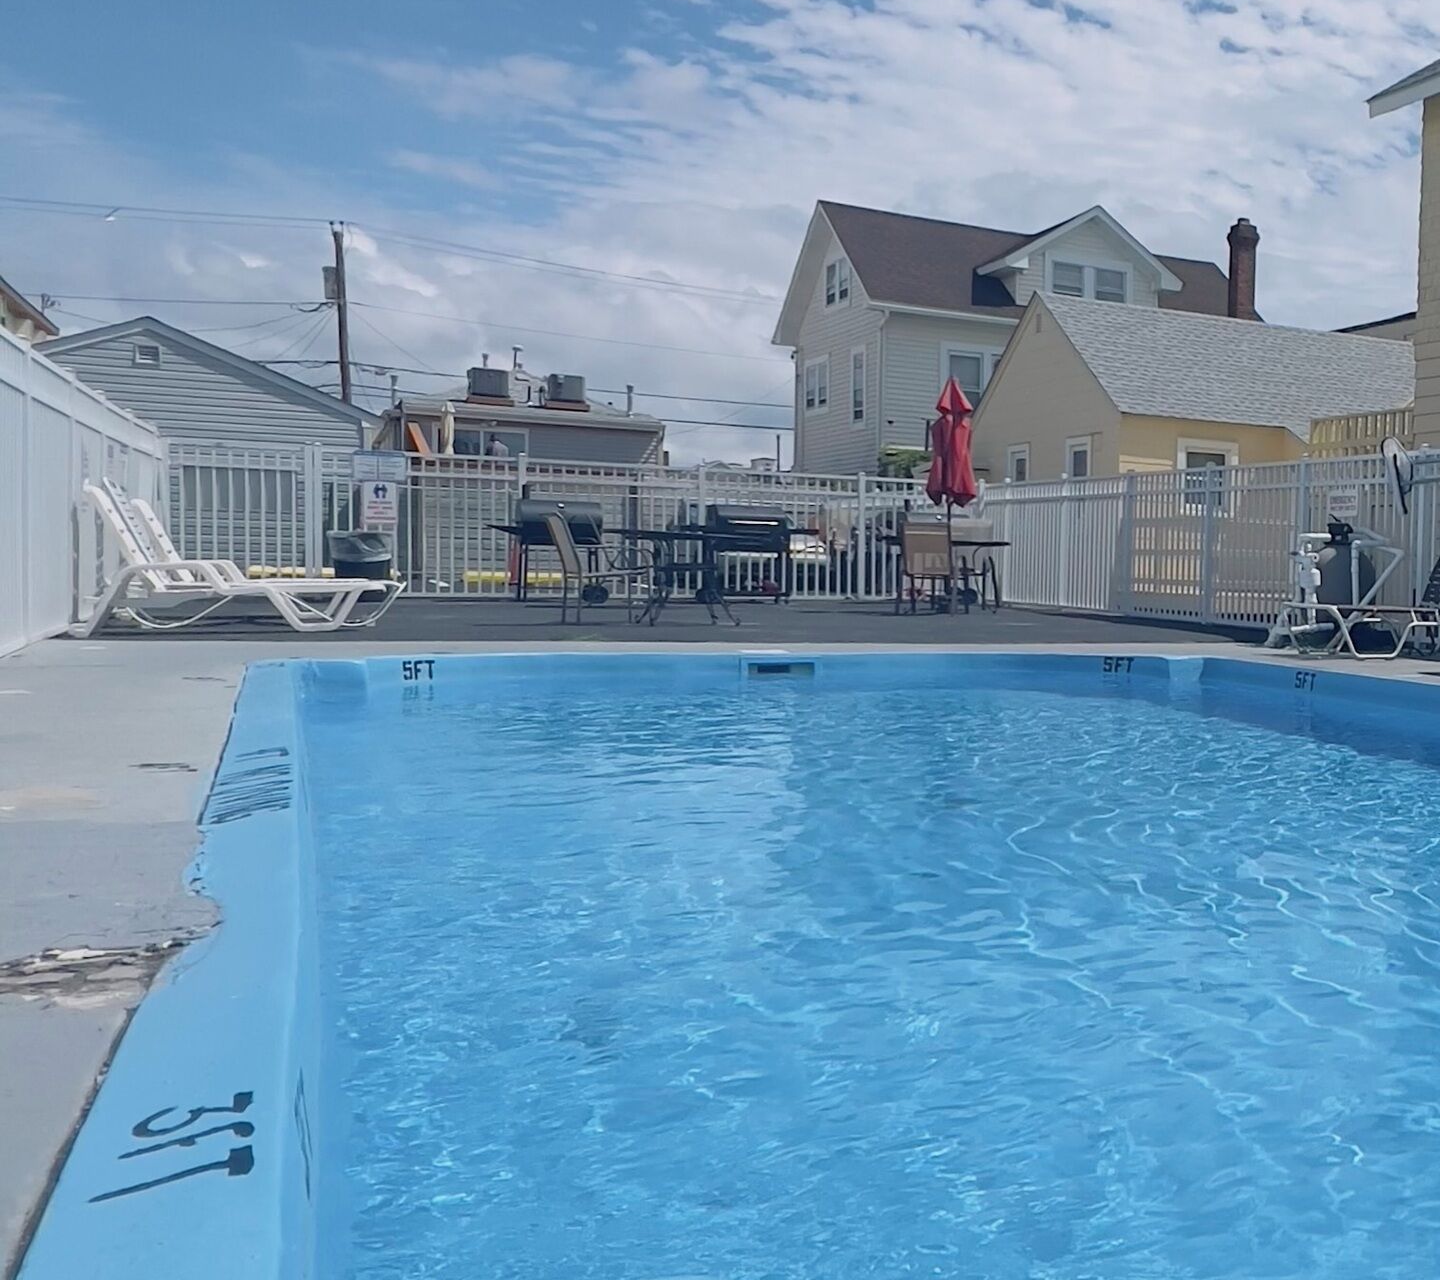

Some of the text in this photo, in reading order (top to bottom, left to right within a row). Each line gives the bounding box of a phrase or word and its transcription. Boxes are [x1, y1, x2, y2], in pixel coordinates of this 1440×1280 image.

[402, 660, 435, 680] 5FT
[1103, 656, 1135, 673] 5FT
[1294, 671, 1317, 691] 5FT
